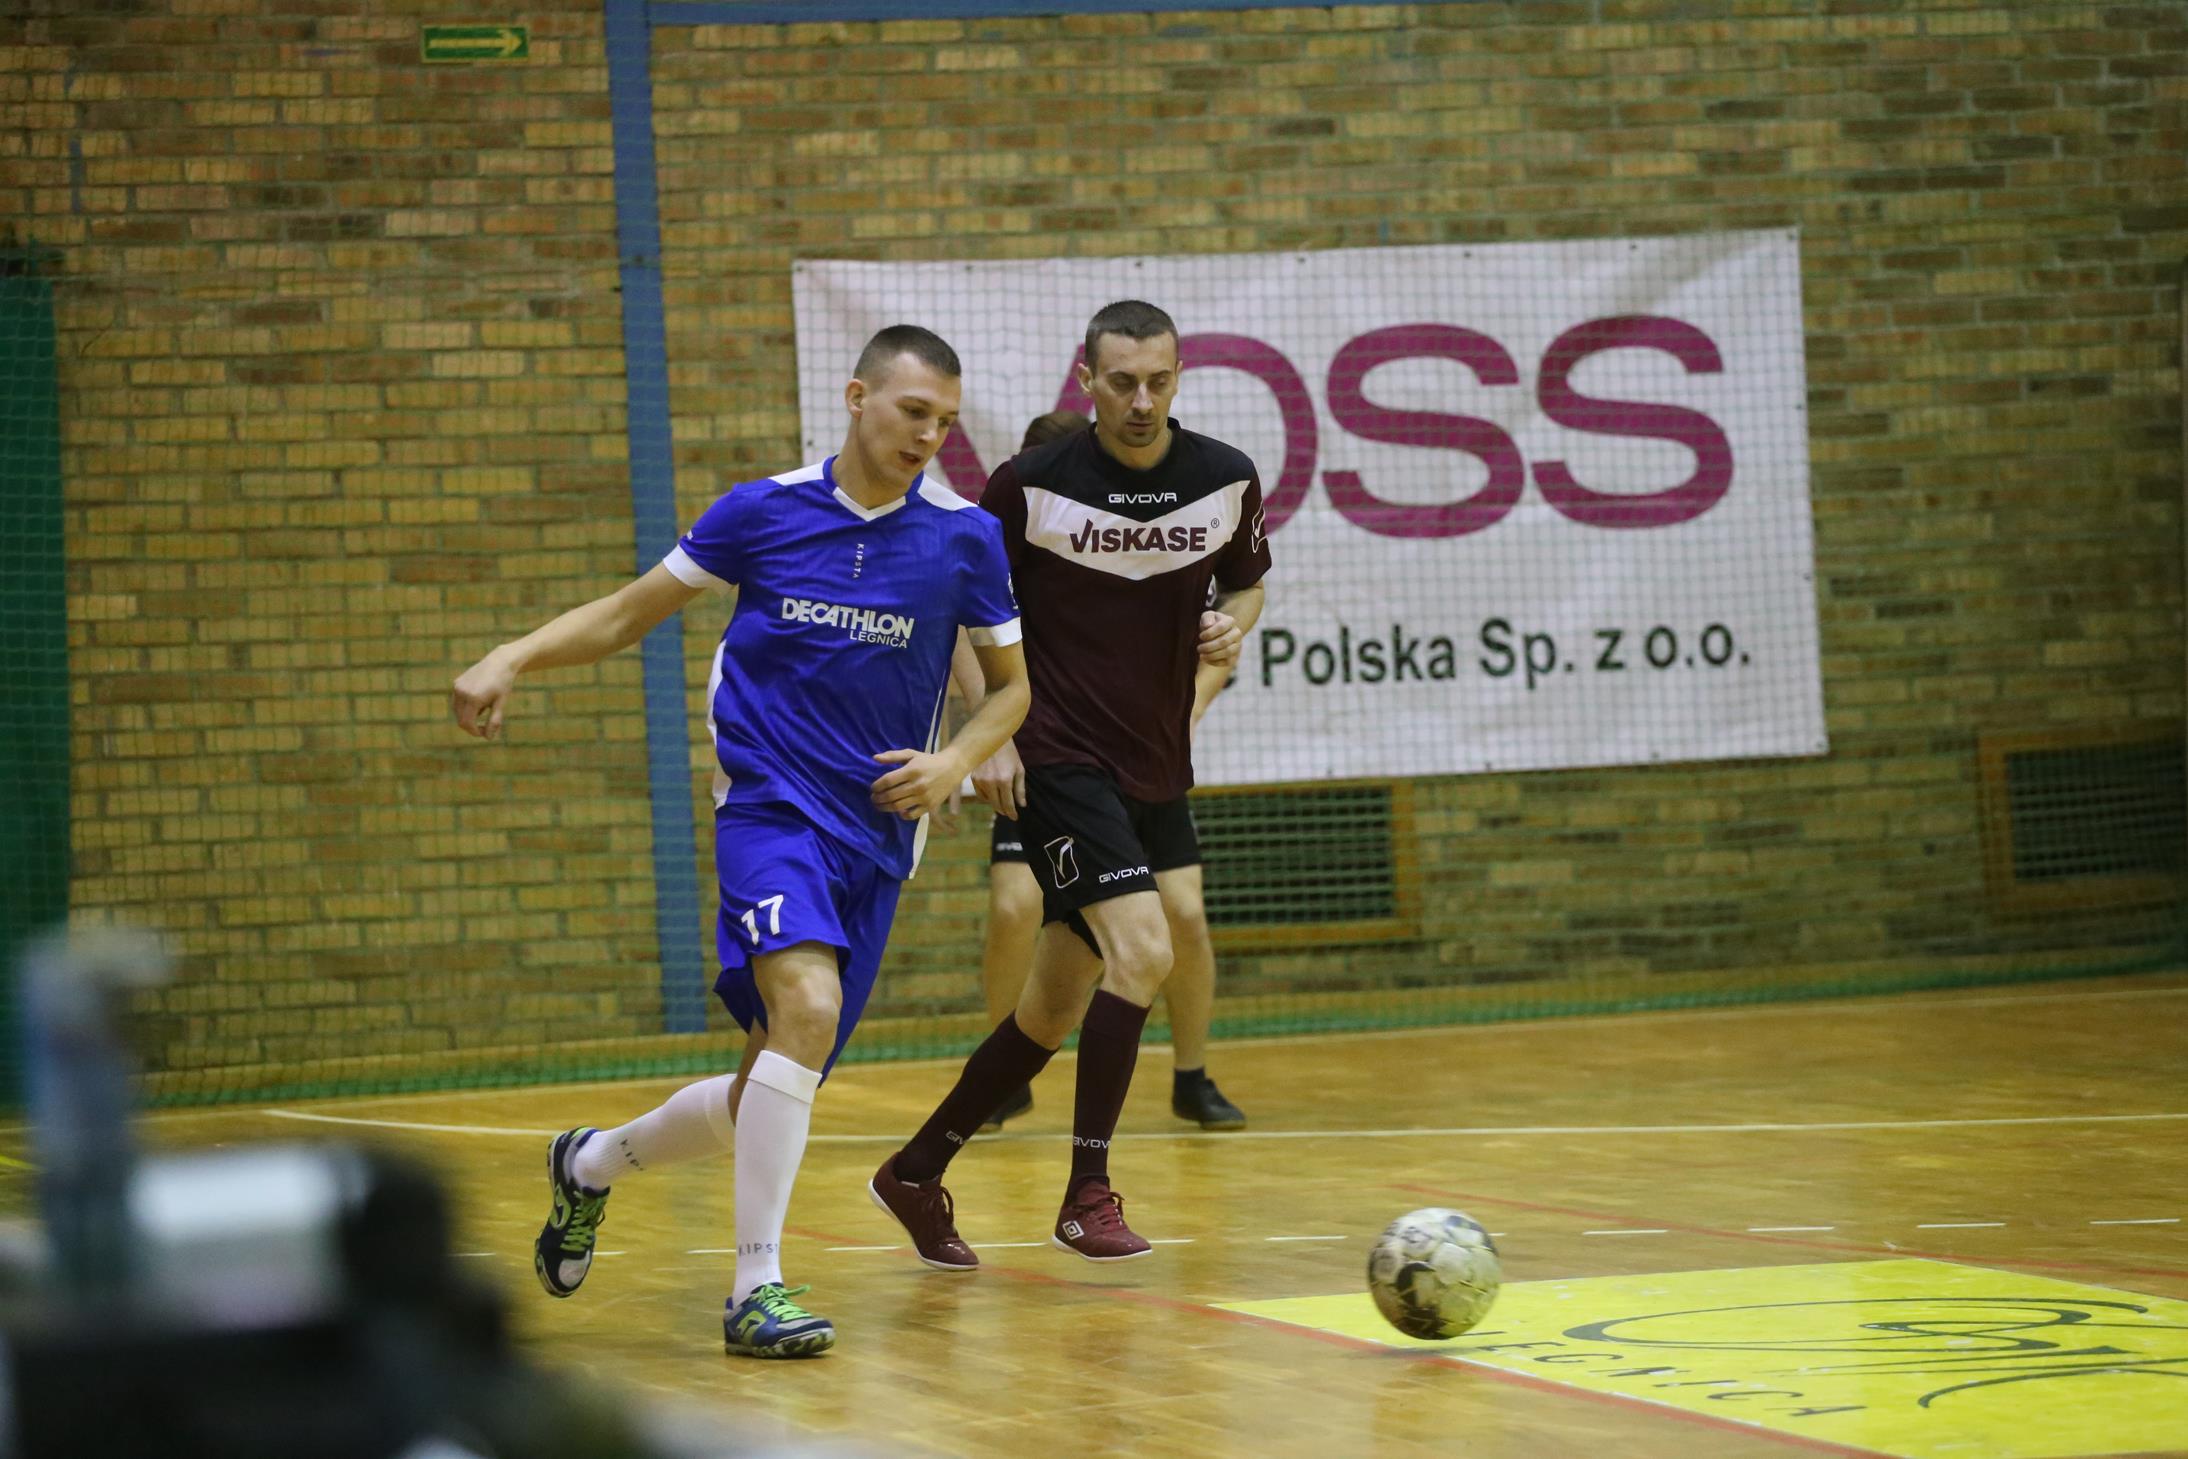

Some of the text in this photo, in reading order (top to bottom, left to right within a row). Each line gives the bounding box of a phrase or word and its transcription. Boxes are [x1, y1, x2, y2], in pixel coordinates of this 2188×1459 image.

[1108, 492, 1177, 504] GIVOVA
[1070, 518, 1207, 553] VISKASE
[852, 543, 864, 579] KIPSTA
[781, 597, 914, 639] DECATHLON
[850, 630, 907, 649] LEGNICA
[1260, 618, 1750, 690] Polska Sp. z o.o.
[1099, 866, 1149, 883] GIVOVA
[741, 894, 784, 945] 17
